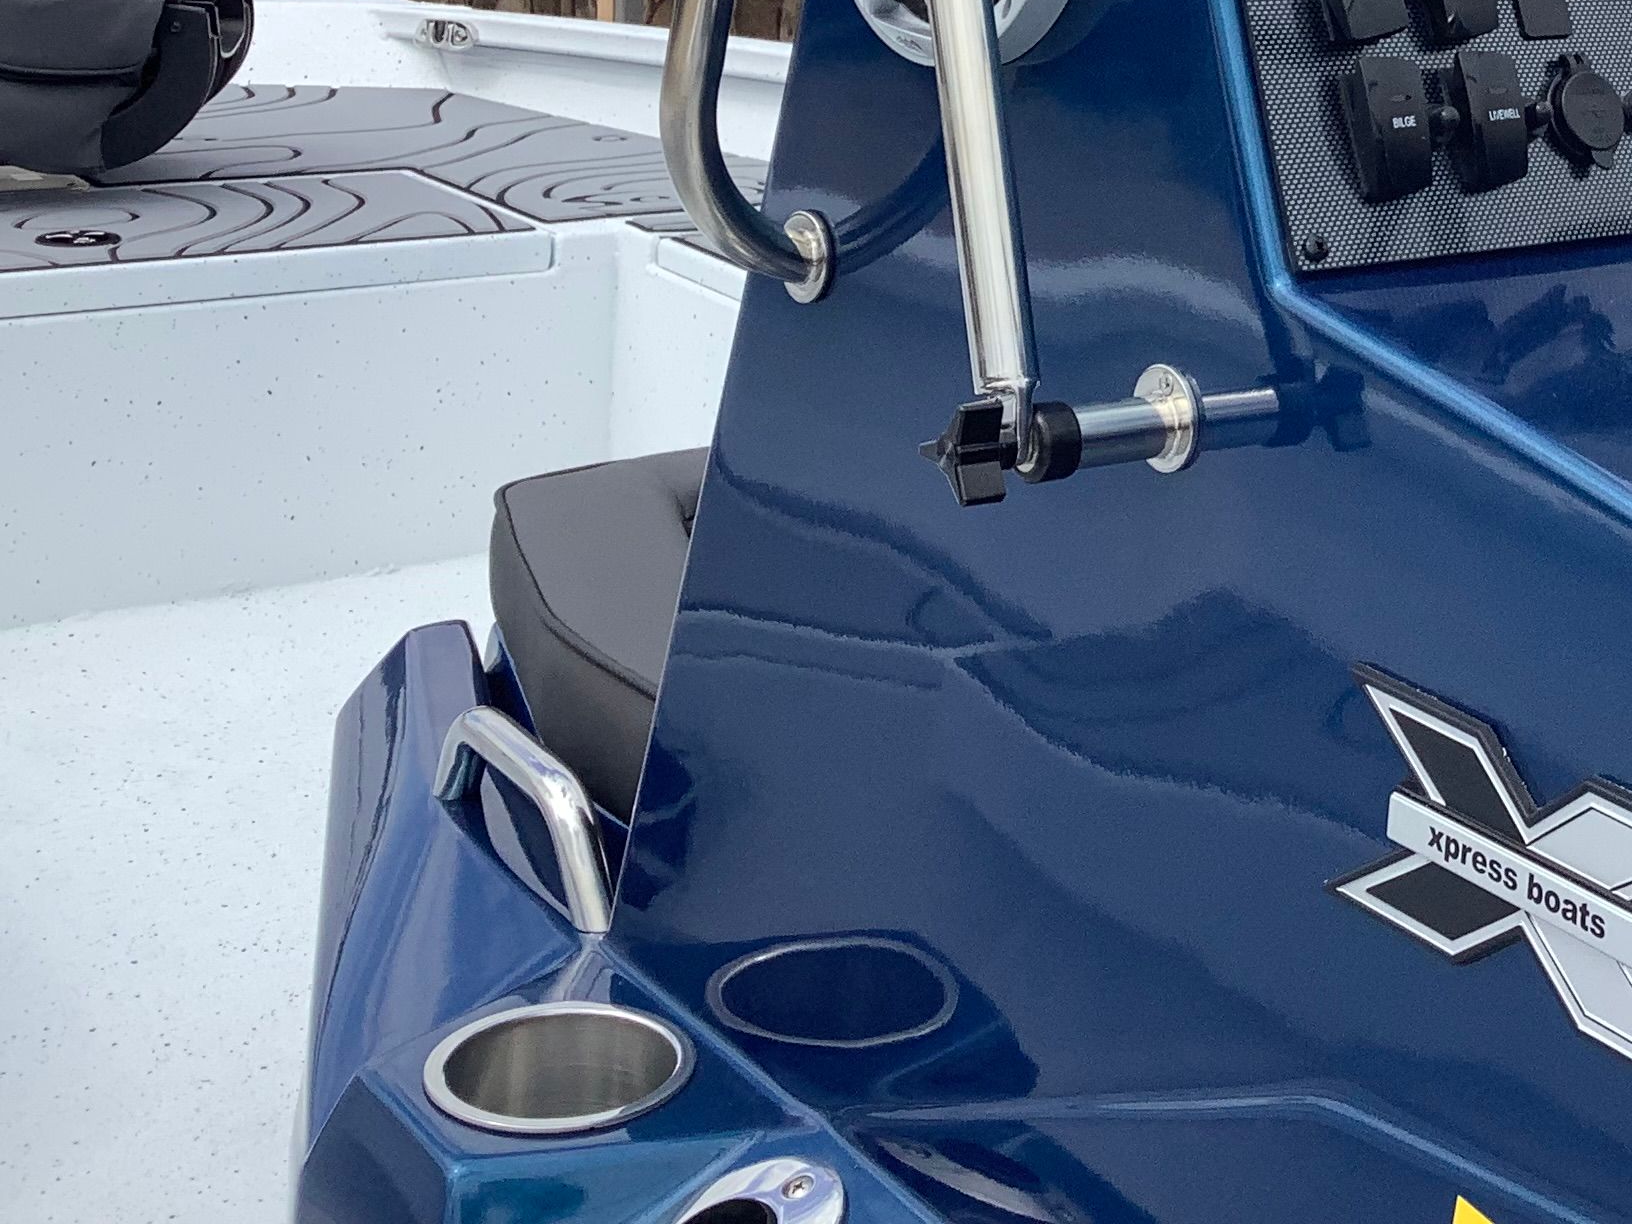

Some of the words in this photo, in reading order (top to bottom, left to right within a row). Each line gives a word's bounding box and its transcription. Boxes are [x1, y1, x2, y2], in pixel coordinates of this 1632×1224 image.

[1488, 107, 1521, 121] LIVEWELL
[1392, 115, 1417, 129] BILGE
[1427, 824, 1519, 892] xpress
[1526, 873, 1607, 939] boats
